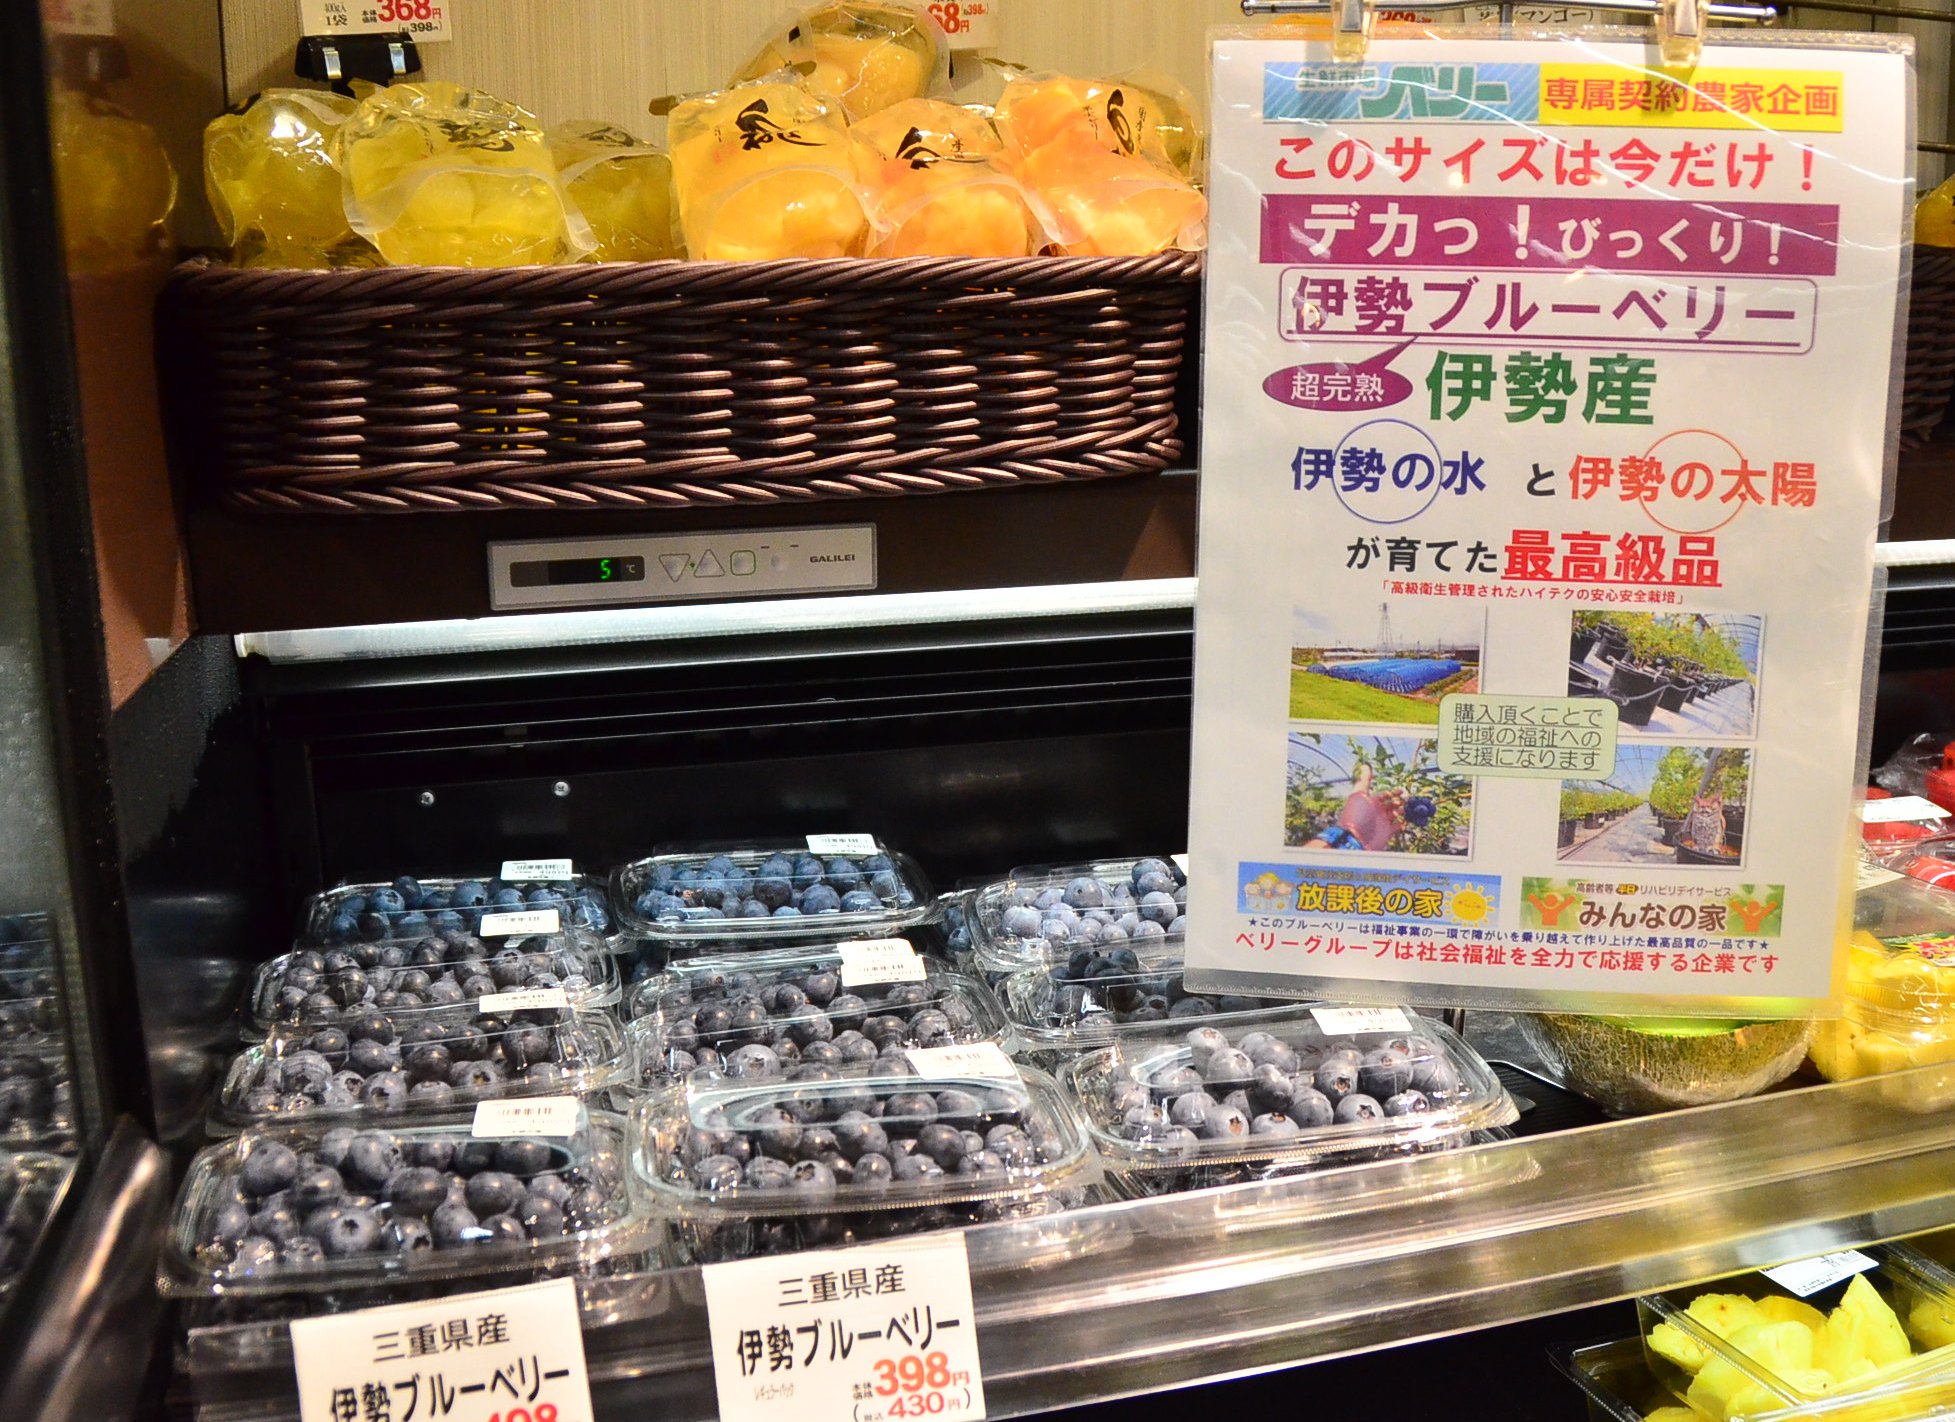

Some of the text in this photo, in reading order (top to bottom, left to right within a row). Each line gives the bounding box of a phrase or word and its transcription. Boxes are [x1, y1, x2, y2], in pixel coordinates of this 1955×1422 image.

[1544, 78, 1839, 118] 専属契約農家企画
[1292, 275, 1796, 342] 伊勢ブルーベリー
[1290, 371, 1386, 403] 超完熟
[1426, 351, 1657, 426] 伊勢産
[1291, 446, 1487, 495] 伊勢の水
[809, 554, 856, 564] GALILEI
[1382, 580, 1686, 605] 「高級衛生管理されたハイテクの安心安全栽培」
[1454, 703, 1603, 727] 購入頂くことで
[1454, 725, 1602, 748] 地域の福祉への
[1452, 747, 1600, 770] 支援になります
[1296, 882, 1444, 917] 放課後の家
[1578, 900, 1728, 932] みんなの家
[1236, 932, 1780, 974] ベリーグループは社会福祉を全力で応援する企業です
[778, 1263, 907, 1307] 三重県産
[373, 1313, 510, 1363] 三重県産
[737, 1304, 961, 1376] 伊勢ブルーベリー
[330, 1355, 570, 1422] 伊勢ブルーベリー
[873, 1351, 970, 1396] 398円
